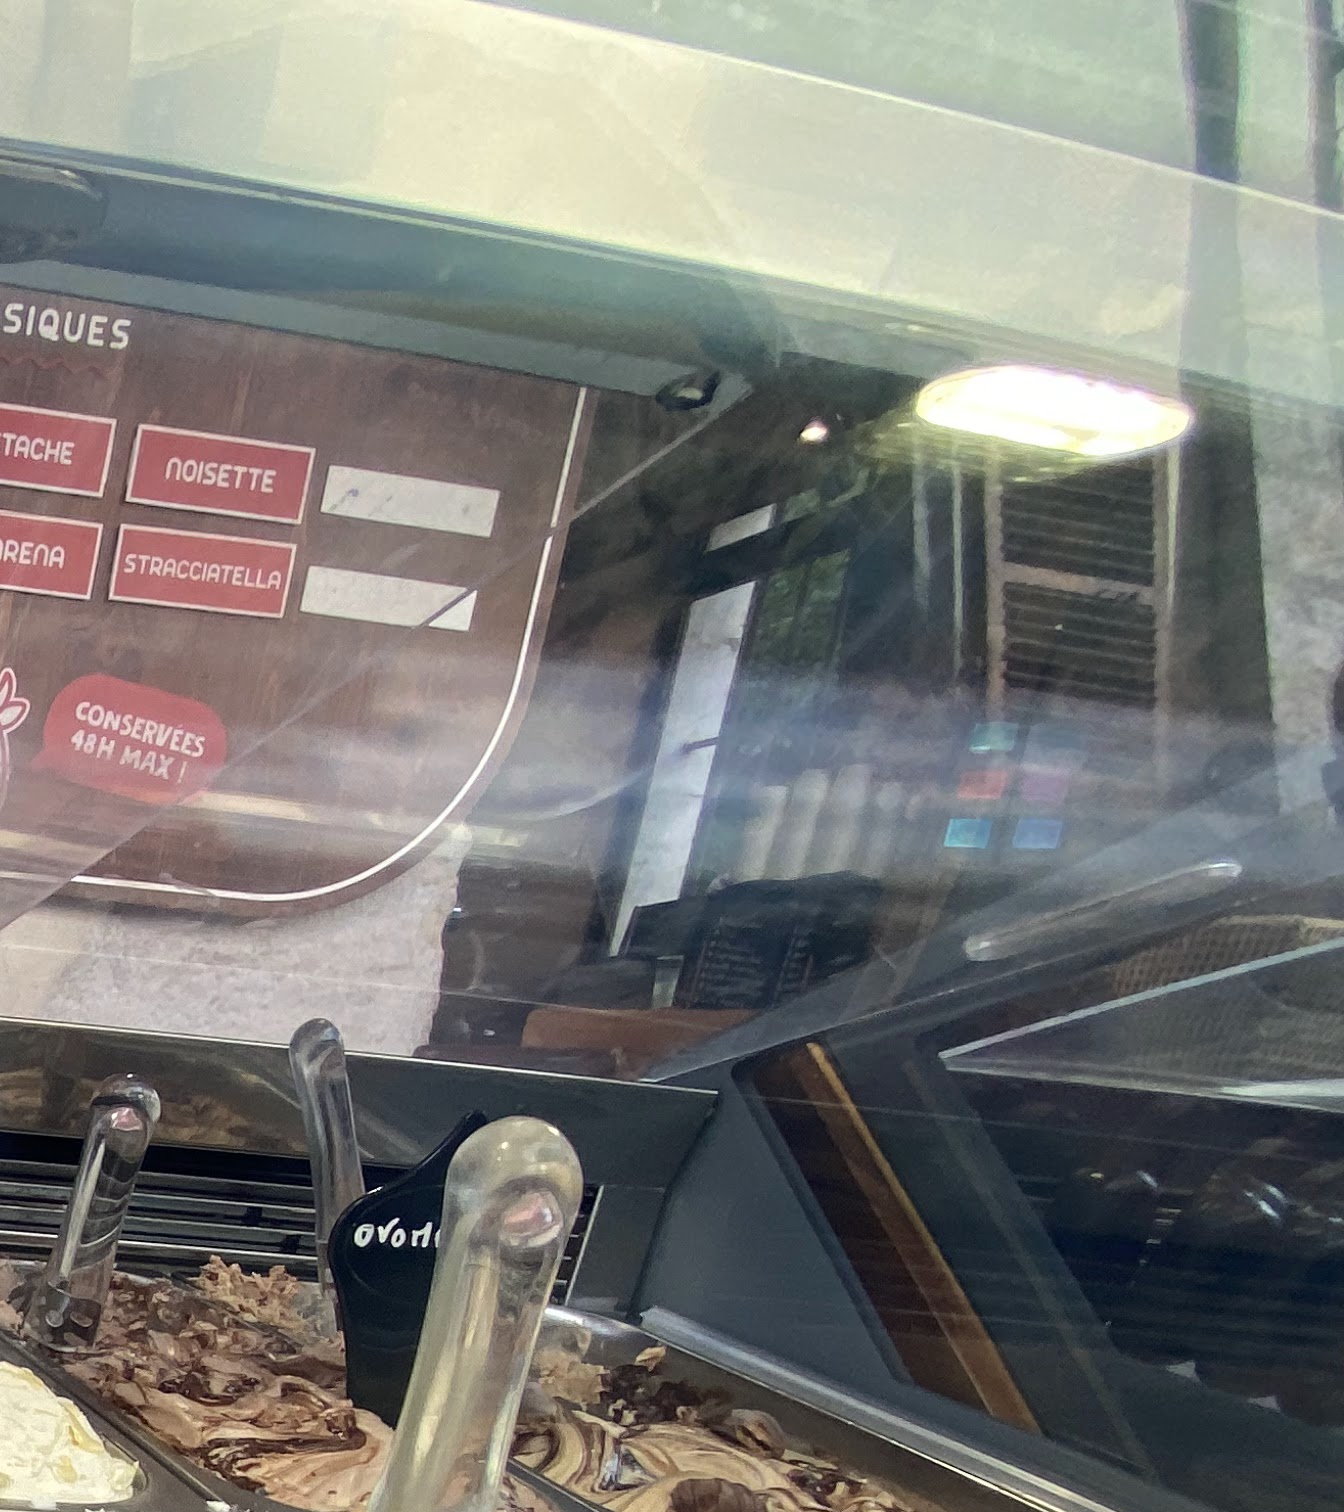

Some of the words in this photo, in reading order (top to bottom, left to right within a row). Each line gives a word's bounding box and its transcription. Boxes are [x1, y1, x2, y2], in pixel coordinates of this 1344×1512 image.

[165, 457, 277, 493] NOISETTE
[124, 554, 282, 590] STRACCIATELLA
[75, 701, 205, 757] CONSERVÉES
[71, 729, 115, 760] 48H
[119, 745, 175, 780] MAX
